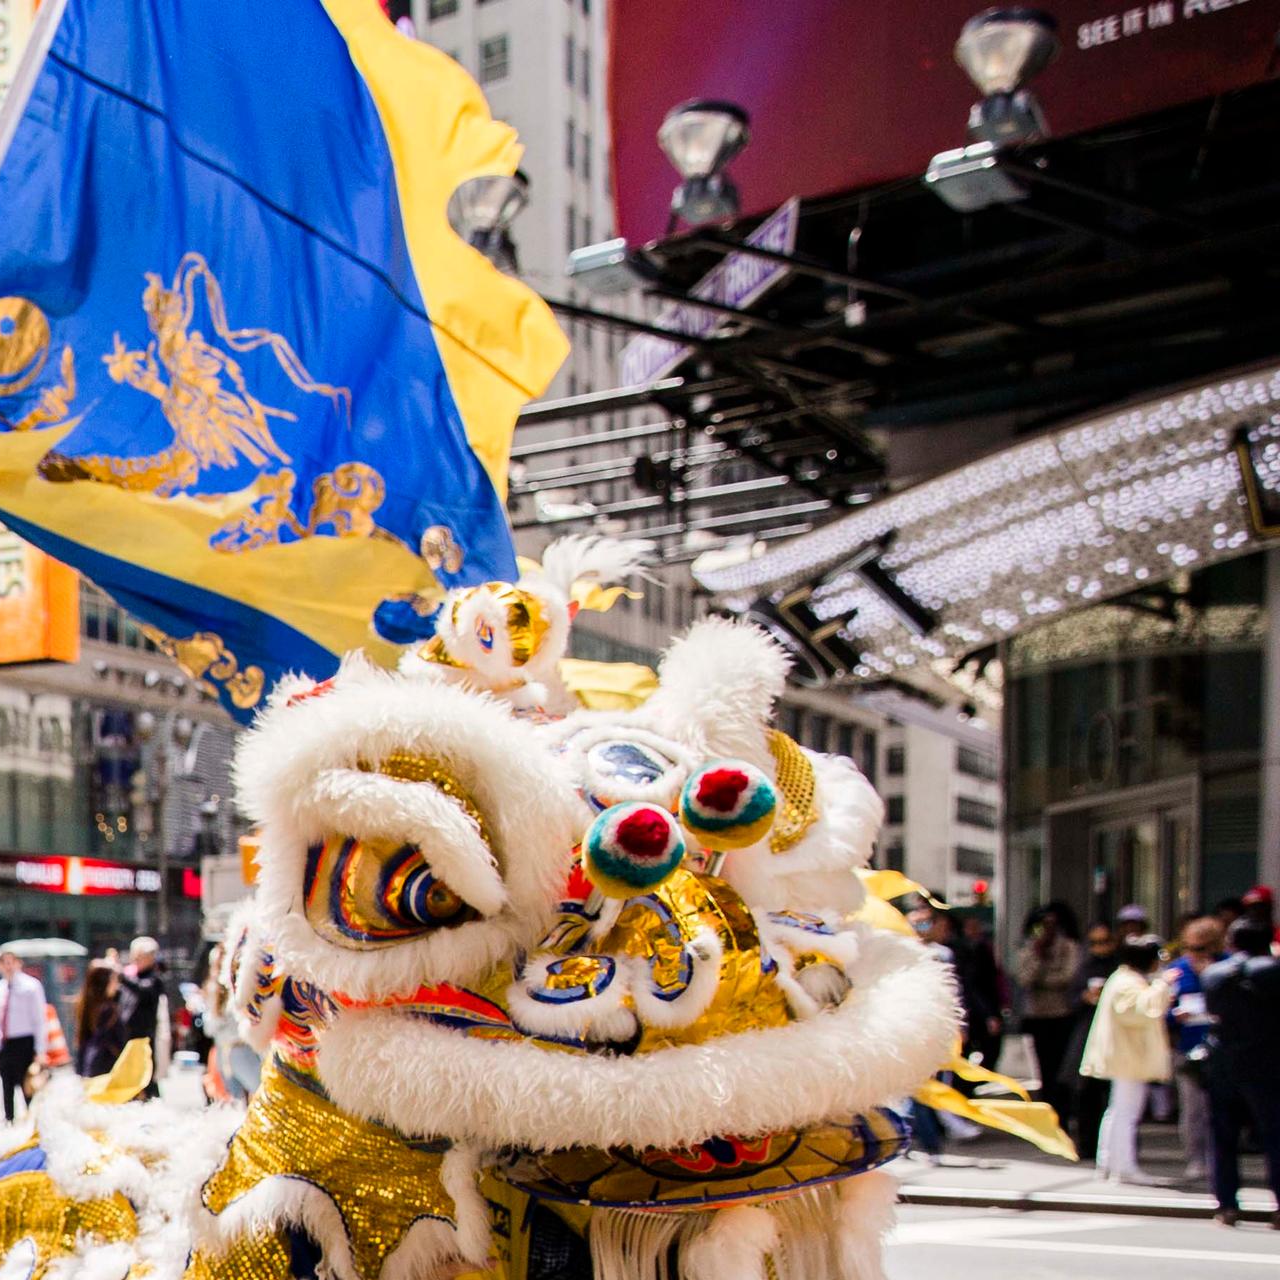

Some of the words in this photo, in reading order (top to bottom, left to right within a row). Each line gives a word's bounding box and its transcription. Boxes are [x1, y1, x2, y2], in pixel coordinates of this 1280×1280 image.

[1077, 14, 1122, 50] SEE
[1122, 7, 1144, 37] IT
[1147, 1, 1174, 30] IN
